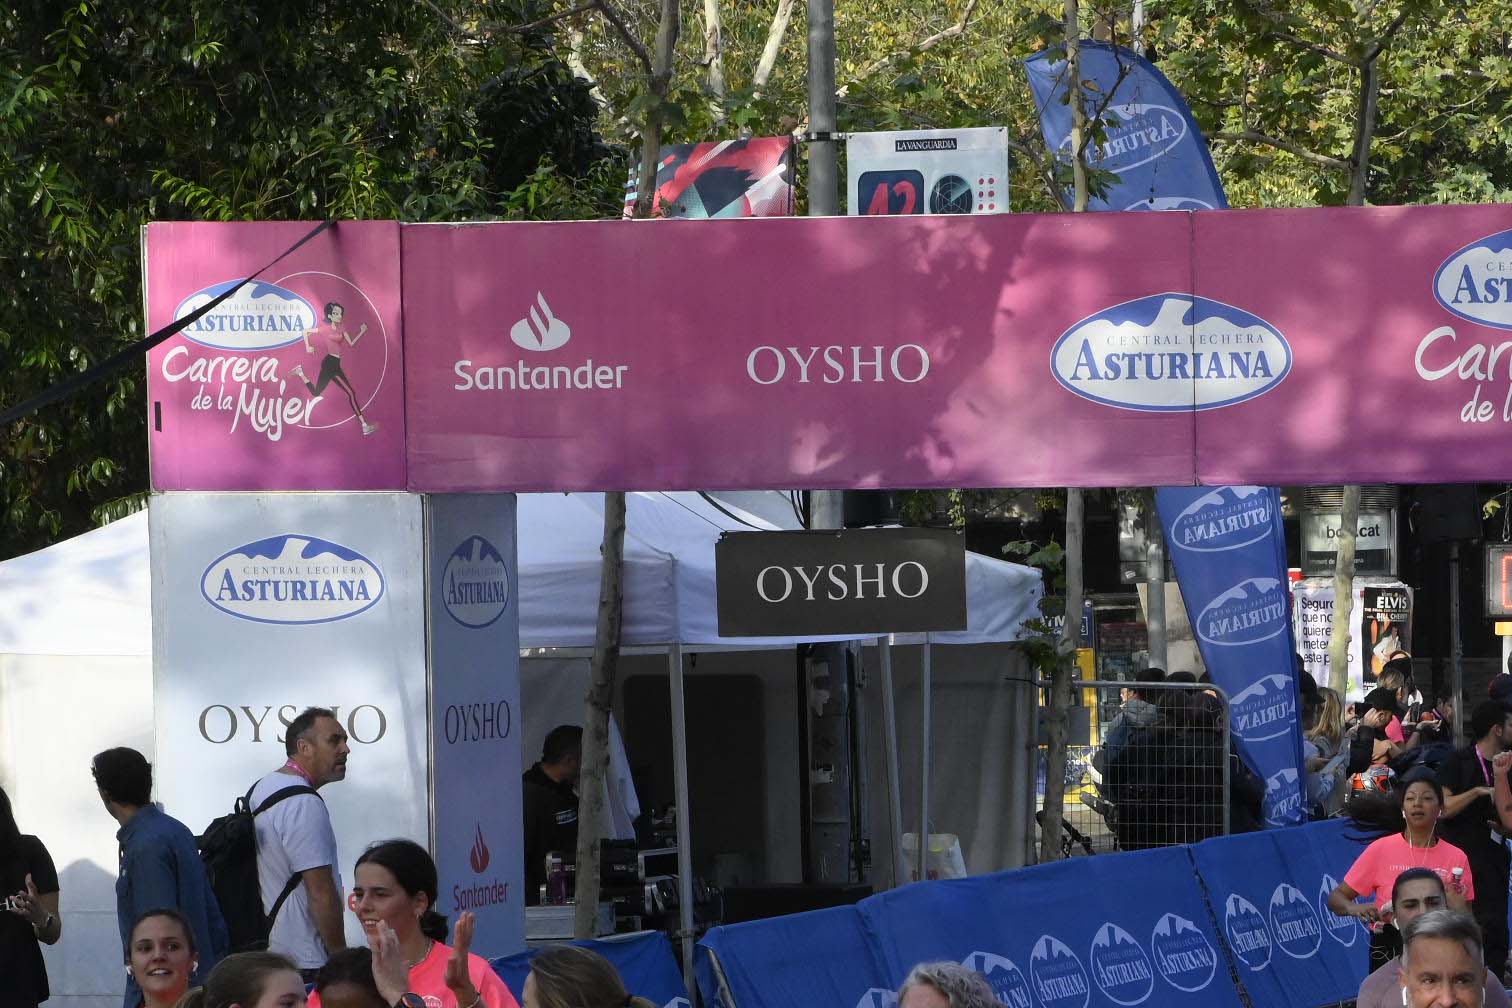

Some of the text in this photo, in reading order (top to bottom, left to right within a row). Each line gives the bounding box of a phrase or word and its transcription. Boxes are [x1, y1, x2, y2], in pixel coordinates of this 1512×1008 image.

[185, 305, 305, 332] ASTURIANA
[1105, 332, 1265, 346] CENTRAL LECHERA
[161, 345, 279, 383] Carrera
[454, 360, 629, 391] Santander
[746, 343, 930, 385] OYSHO
[1069, 338, 1274, 381] ASTURIANA
[191, 380, 324, 442] de la Mujer
[1460, 384, 1495, 423] de
[215, 568, 371, 602] ASTURIANA
[242, 565, 365, 576] CENTRAL LECHERA
[756, 560, 929, 604] OYSHO
[447, 574, 505, 607] ASTURIANA
[1376, 596, 1408, 609] ELVIS
[1302, 613, 1320, 624] que
[1304, 651, 1322, 663] este
[198, 704, 388, 744] OYSO
[444, 700, 511, 745] OYSHO
[453, 882, 510, 912] Santander
[1276, 915, 1318, 943] ASTURIANA
[1040, 970, 1088, 1002] ASTURIANA
[1099, 954, 1151, 989] ASTURIANA
